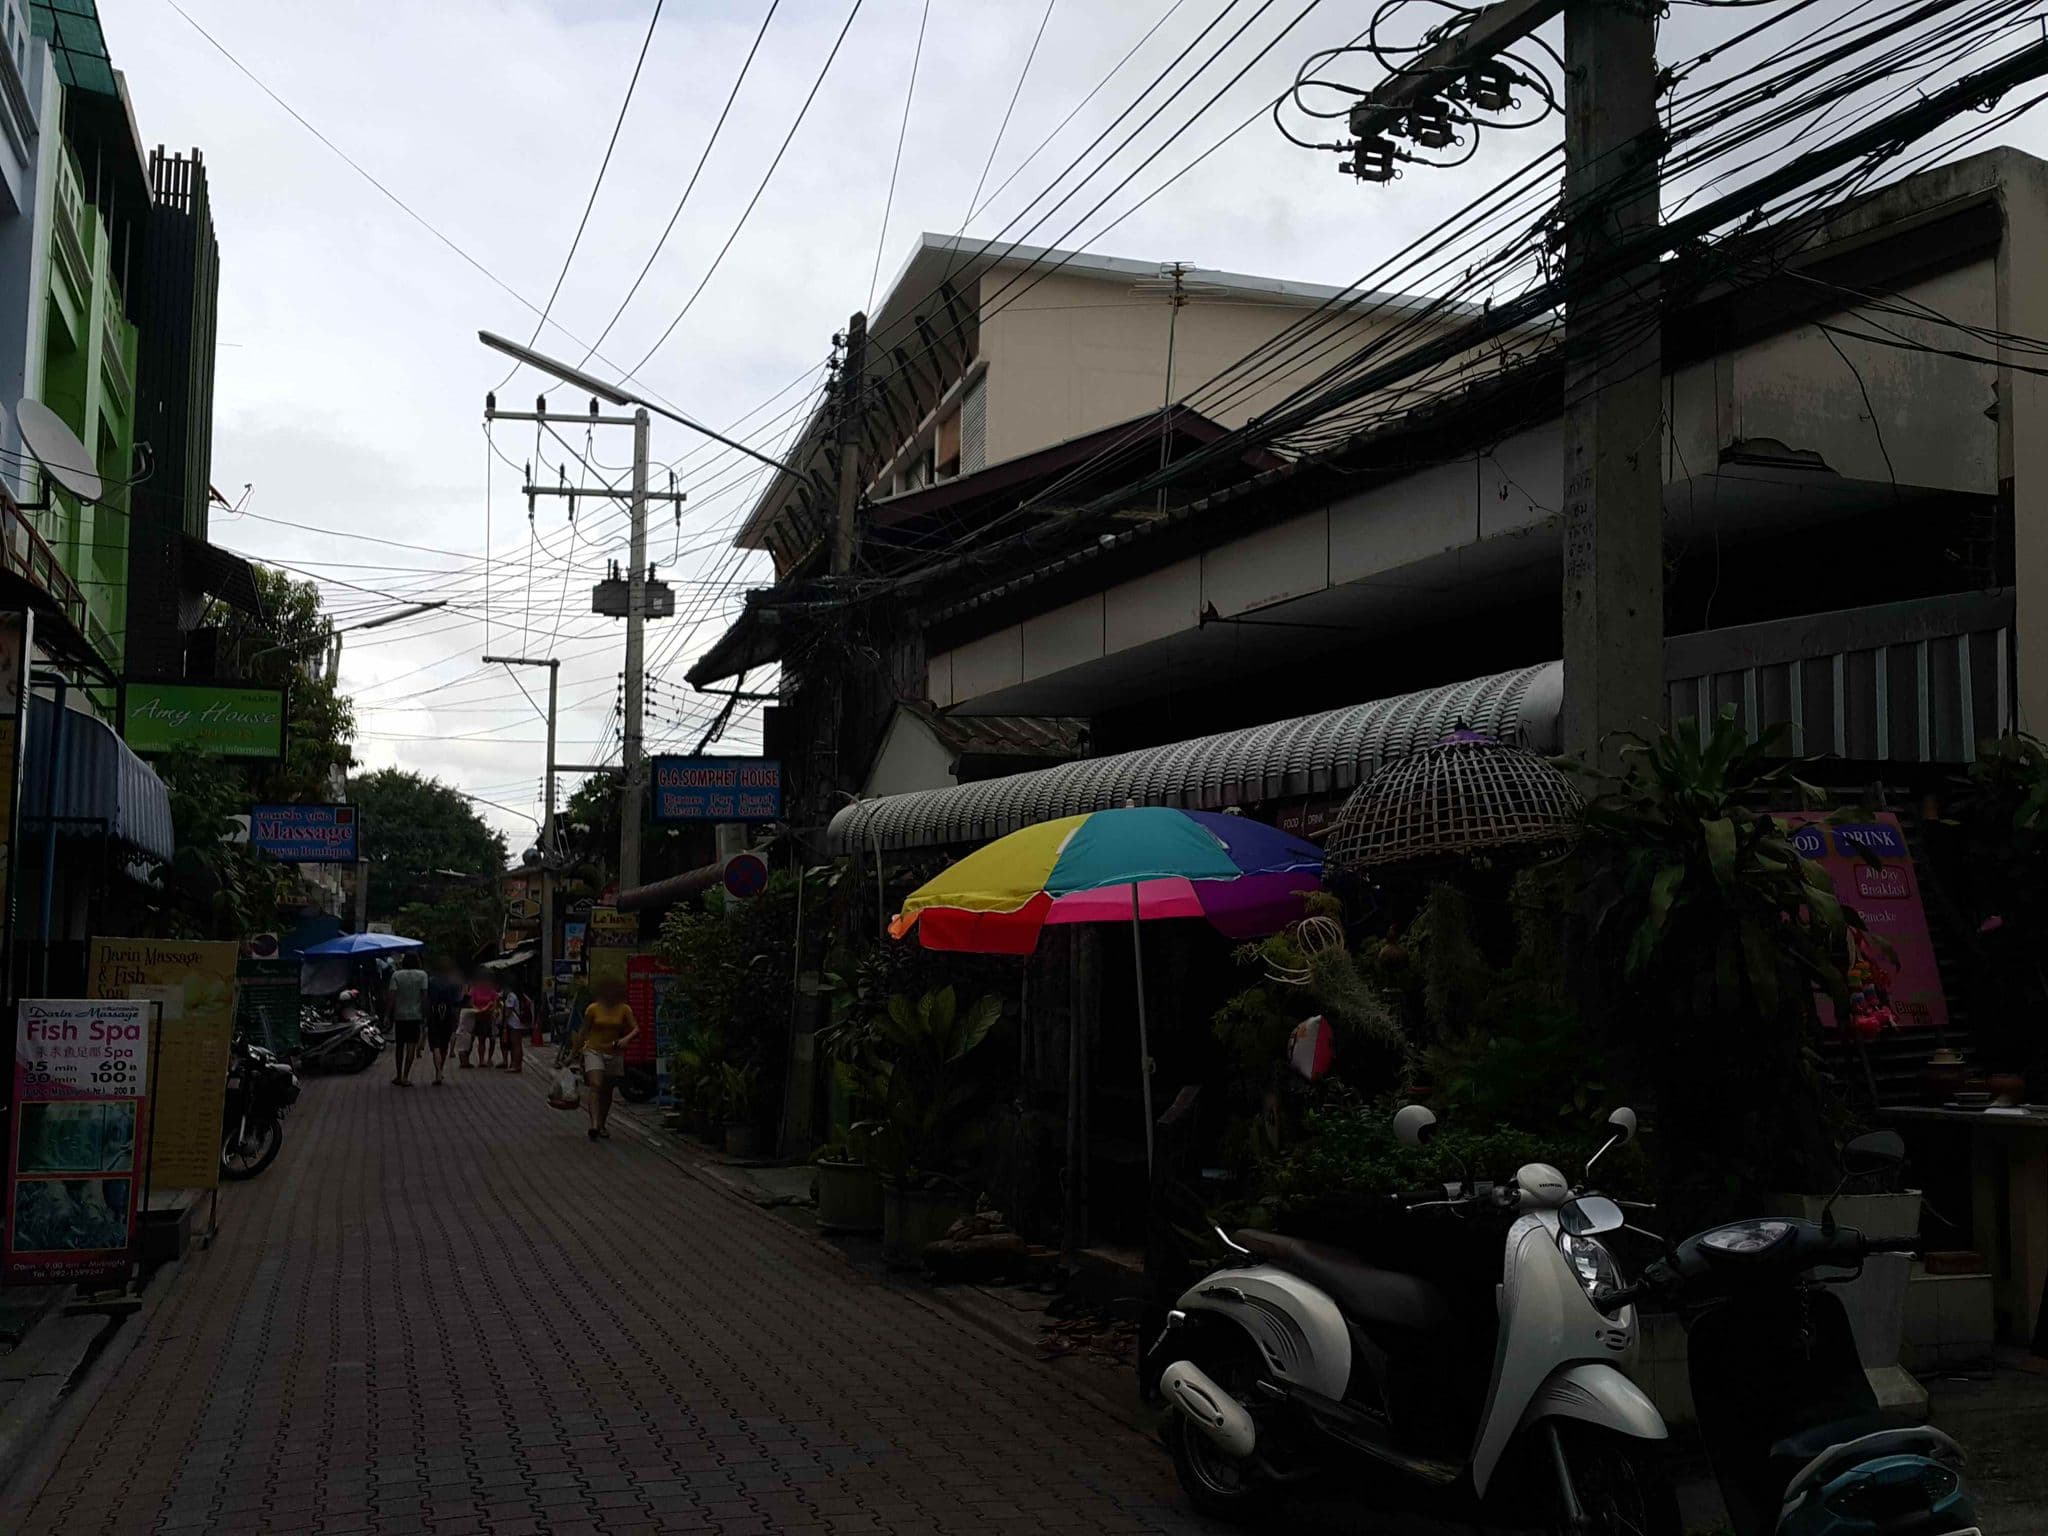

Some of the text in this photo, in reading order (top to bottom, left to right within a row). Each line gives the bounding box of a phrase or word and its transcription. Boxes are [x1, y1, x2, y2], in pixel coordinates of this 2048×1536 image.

[131, 697, 277, 728] Amy House
[741, 768, 779, 787] HOUSE
[257, 821, 352, 845] Massage
[1842, 831, 1896, 848] DRINK
[1860, 883, 1906, 897] Breakfast
[100, 945, 202, 967] Darin Massage
[114, 964, 146, 986] Fish
[29, 1006, 72, 1018] Darin
[75, 1007, 139, 1021] Massage
[27, 1019, 140, 1045] Fish Spa
[104, 1047, 133, 1060] Spa
[26, 1061, 48, 1072] 15
[55, 1064, 77, 1072] min
[99, 1060, 126, 1071] 60
[25, 1073, 50, 1083] 30
[55, 1075, 77, 1083] min
[90, 1072, 126, 1083] 100
